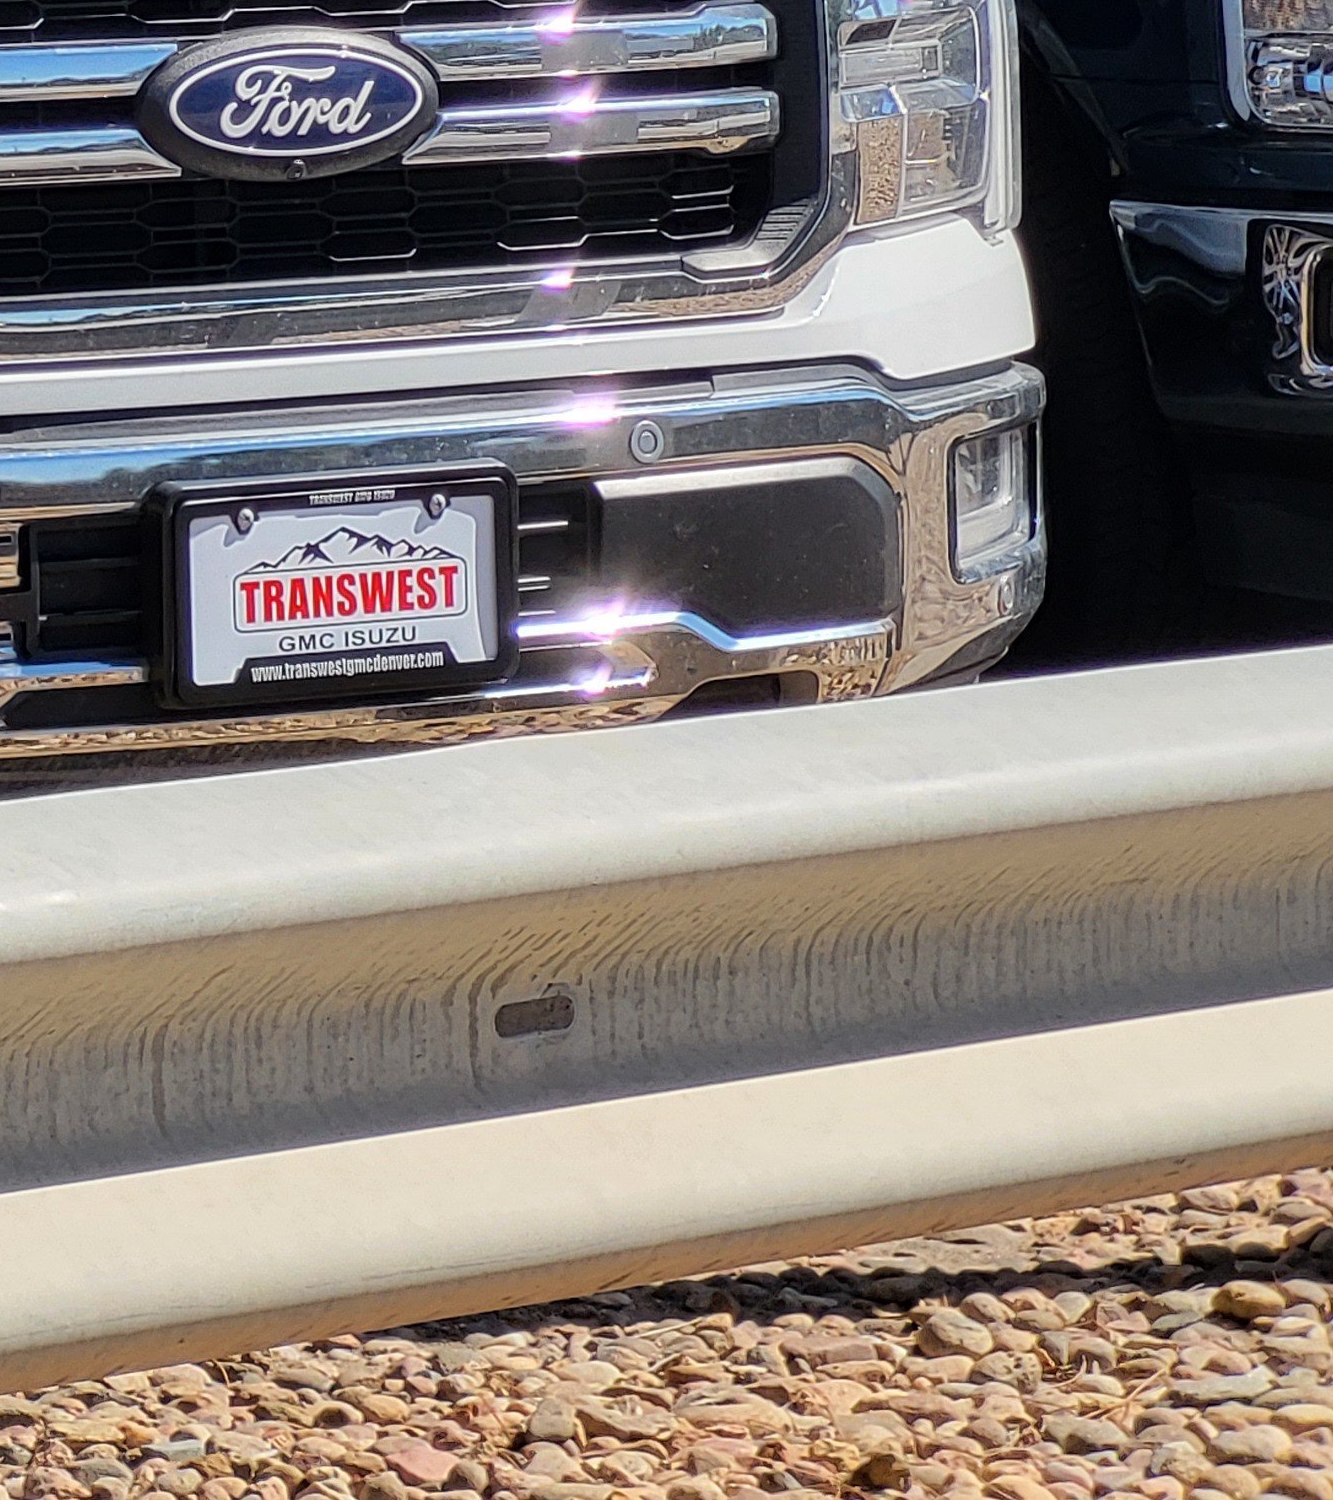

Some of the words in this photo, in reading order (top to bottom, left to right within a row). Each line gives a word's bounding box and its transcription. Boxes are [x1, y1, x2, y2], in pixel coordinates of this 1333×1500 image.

[219, 65, 375, 139] Ford
[239, 565, 459, 625] TRANSWEST
[279, 632, 335, 652] GMC
[344, 625, 417, 647] ISUZU
[250, 650, 444, 683] www.transwestgmcdenver.com
